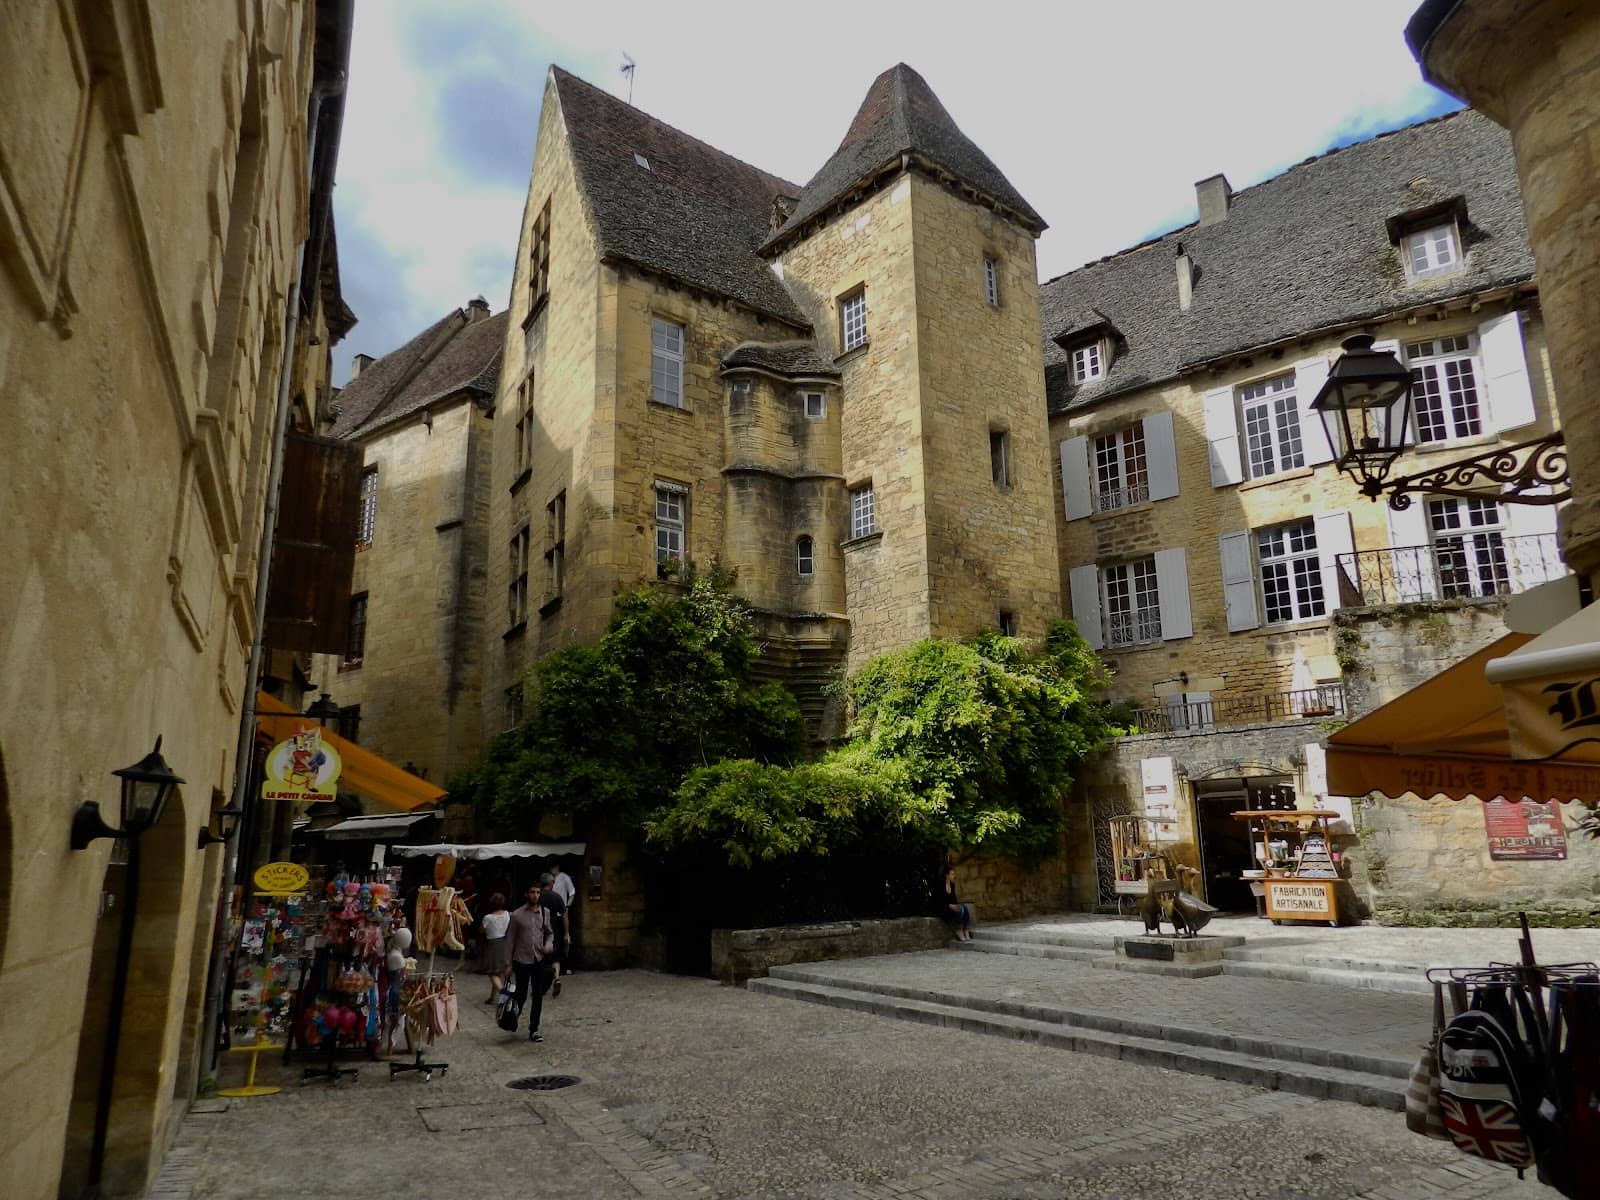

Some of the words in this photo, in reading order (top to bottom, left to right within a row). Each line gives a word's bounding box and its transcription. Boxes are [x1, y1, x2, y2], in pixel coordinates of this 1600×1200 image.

[266, 791, 276, 799] LE
[260, 866, 305, 882] STICKERS
[1273, 886, 1325, 897] FABRICATION
[1275, 898, 1324, 910] ARTISANALE
